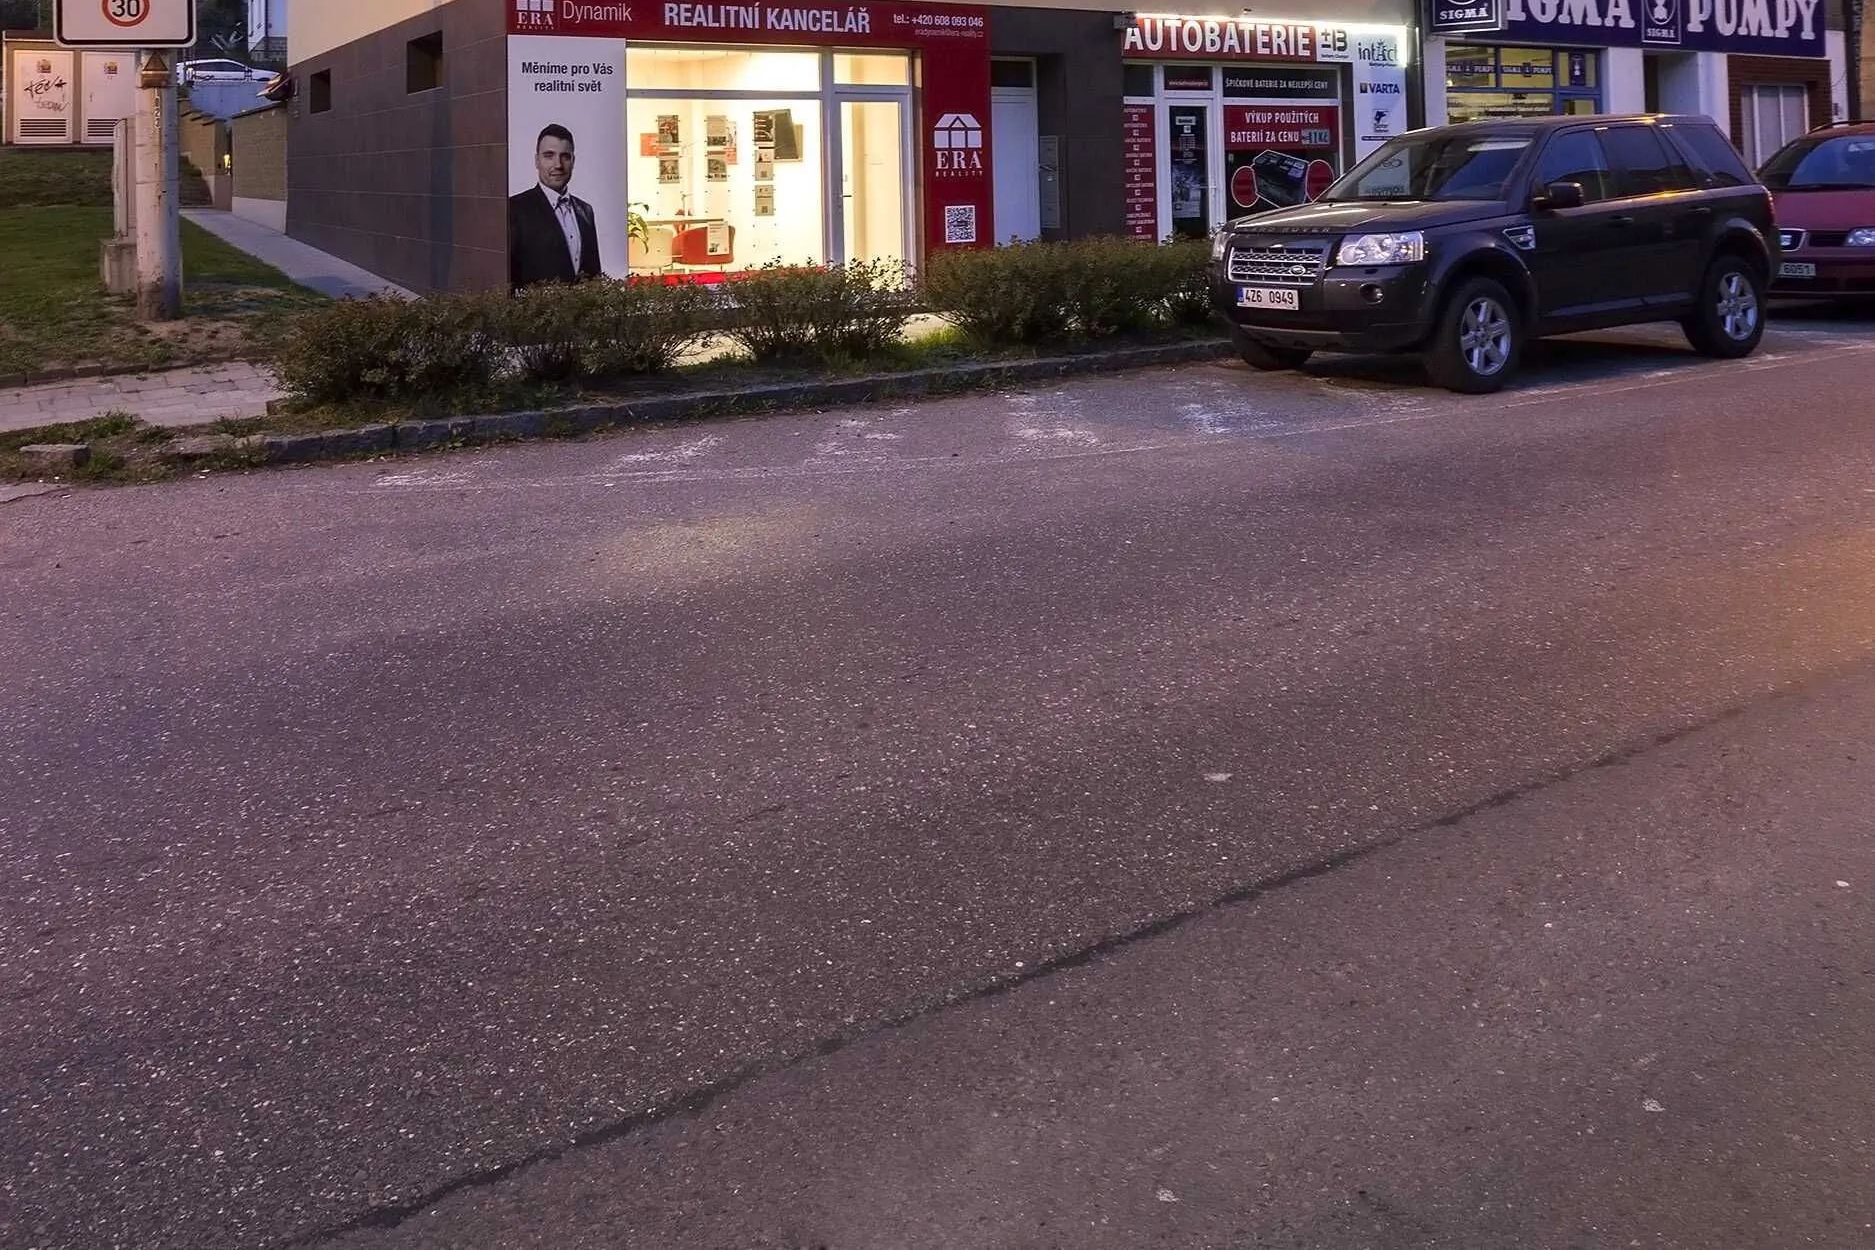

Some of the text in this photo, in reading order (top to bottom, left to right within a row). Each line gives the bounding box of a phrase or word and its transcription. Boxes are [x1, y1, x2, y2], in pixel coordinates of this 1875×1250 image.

[516, 11, 554, 26] ERA
[563, 0, 633, 24] Dynamik
[663, 1, 871, 34] REALITNÍ KANCELÁŘ
[1439, 7, 1489, 20] SIGMA
[1124, 18, 1311, 57] AUTOBATERIE
[1647, 27, 1676, 39] SIGMA
[521, 60, 613, 77] Měníme pro Vás
[534, 79, 602, 92] realitní svět
[1279, 80, 1287, 88] ZA
[1369, 83, 1400, 94] VARTA
[1244, 109, 1320, 124] VÝKUP POUŽITÝCH
[1230, 129, 1264, 143] BATERIÍ
[1265, 131, 1276, 143] ZA
[1278, 131, 1300, 142] CENU
[935, 150, 983, 170] ERA
[935, 170, 983, 178] REALITY
[1245, 289, 1294, 305] 4Z6 0949
